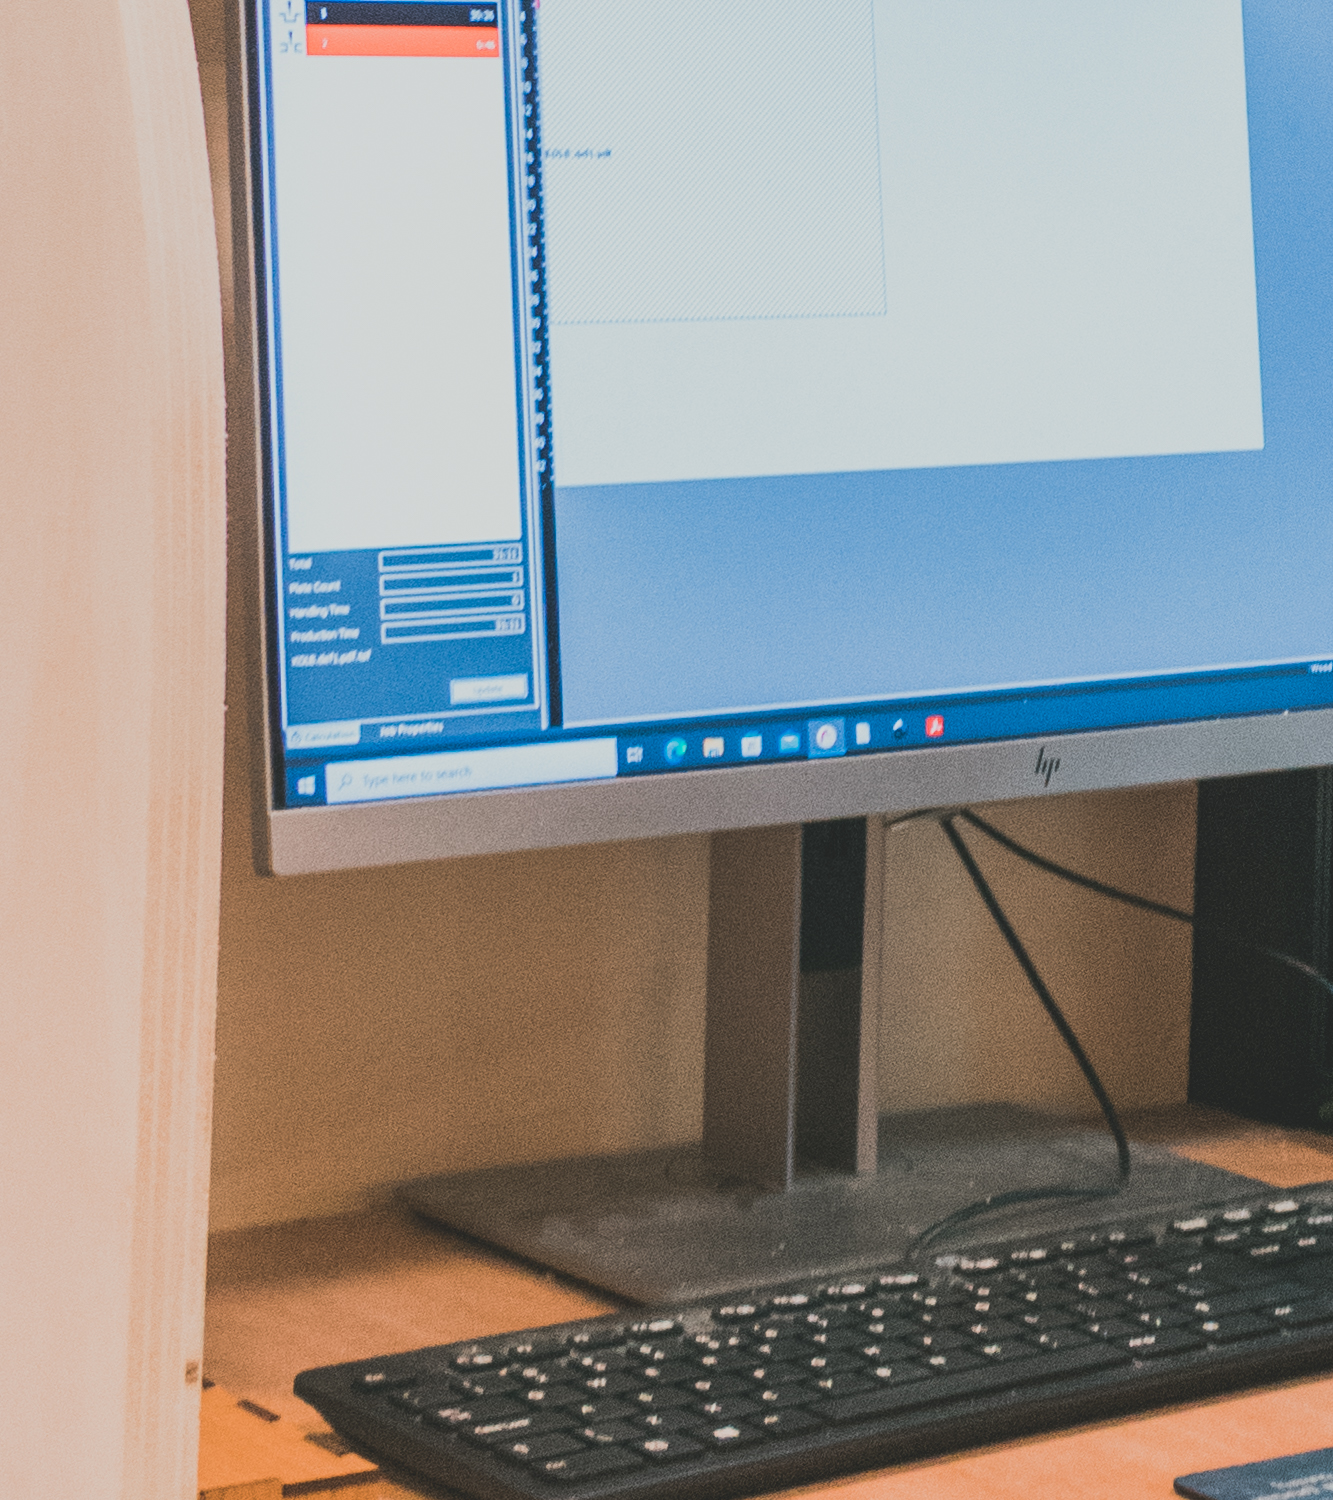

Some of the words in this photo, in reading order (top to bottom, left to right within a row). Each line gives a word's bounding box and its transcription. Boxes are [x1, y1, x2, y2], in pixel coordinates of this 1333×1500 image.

[288, 557, 312, 570] Total
[313, 580, 341, 593] Count
[329, 604, 351, 616] Time
[290, 629, 338, 643] Production
[338, 627, 360, 640] Time
[1034, 745, 1061, 788] hp
[363, 773, 389, 789] Type
[392, 771, 420, 784] here
[421, 770, 433, 781] to
[436, 766, 473, 779] search
